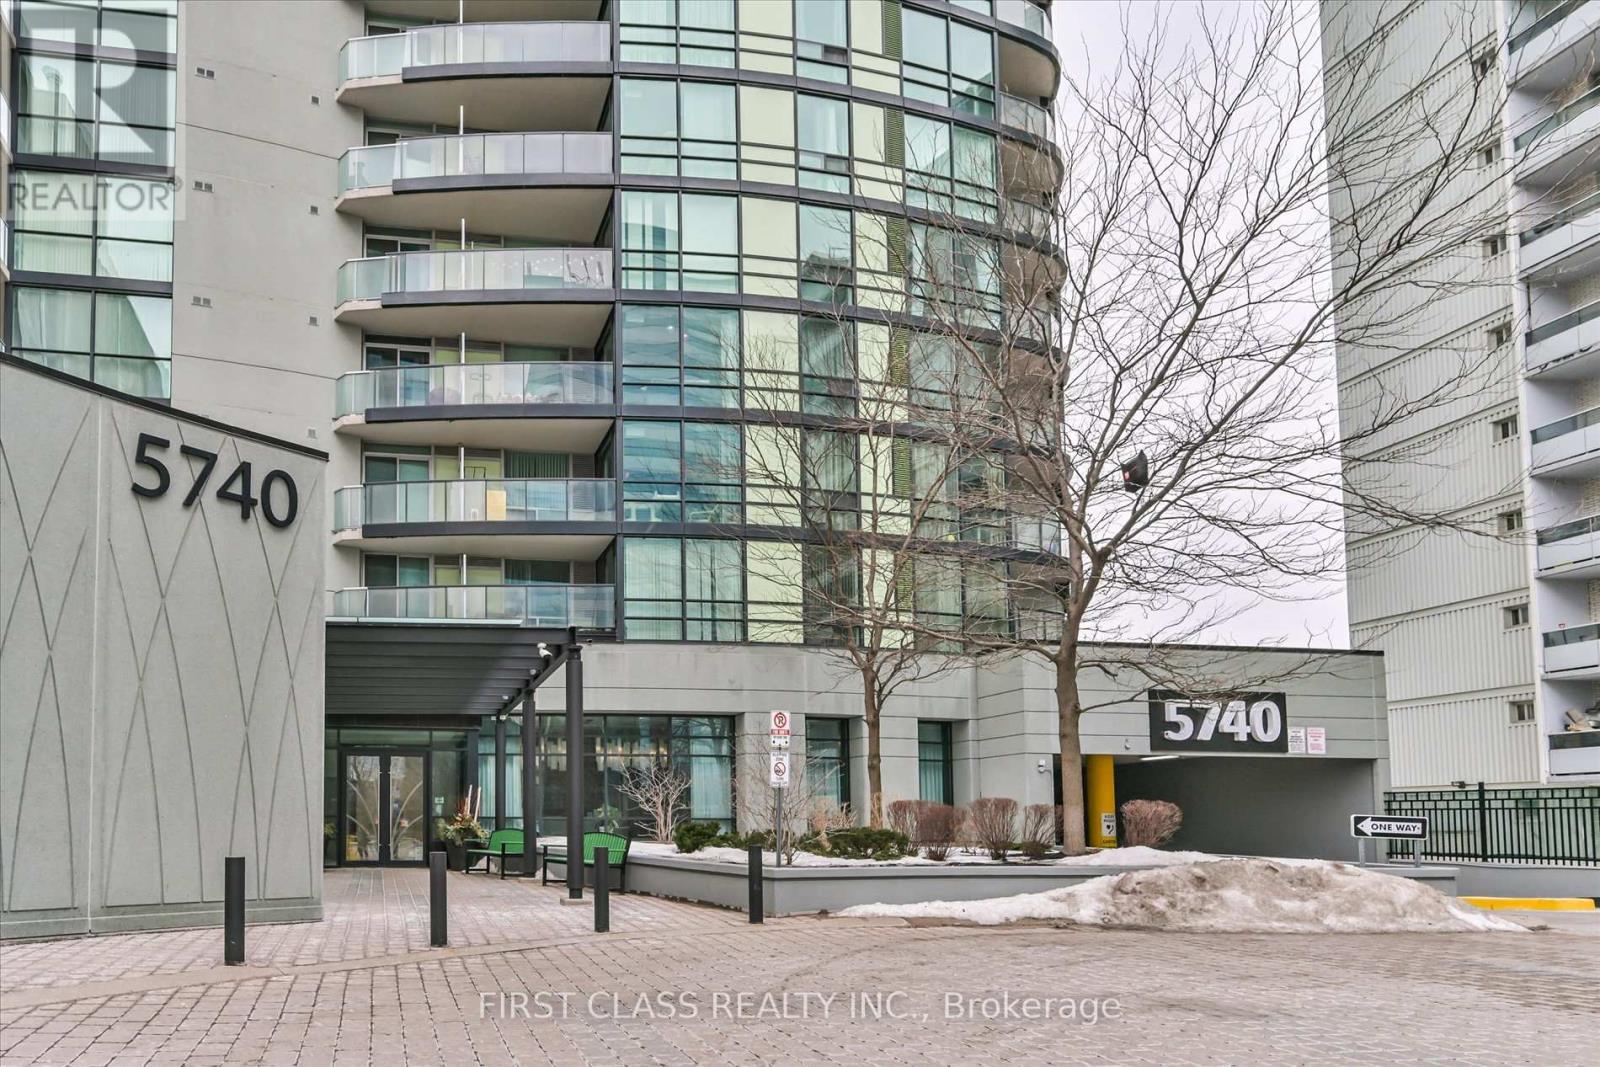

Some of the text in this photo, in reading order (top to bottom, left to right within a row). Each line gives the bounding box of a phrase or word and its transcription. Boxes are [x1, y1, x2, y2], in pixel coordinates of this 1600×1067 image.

[131, 432, 298, 529] 5740
[1163, 698, 1281, 742] 5740
[1371, 823, 1417, 832] ONE WAY
